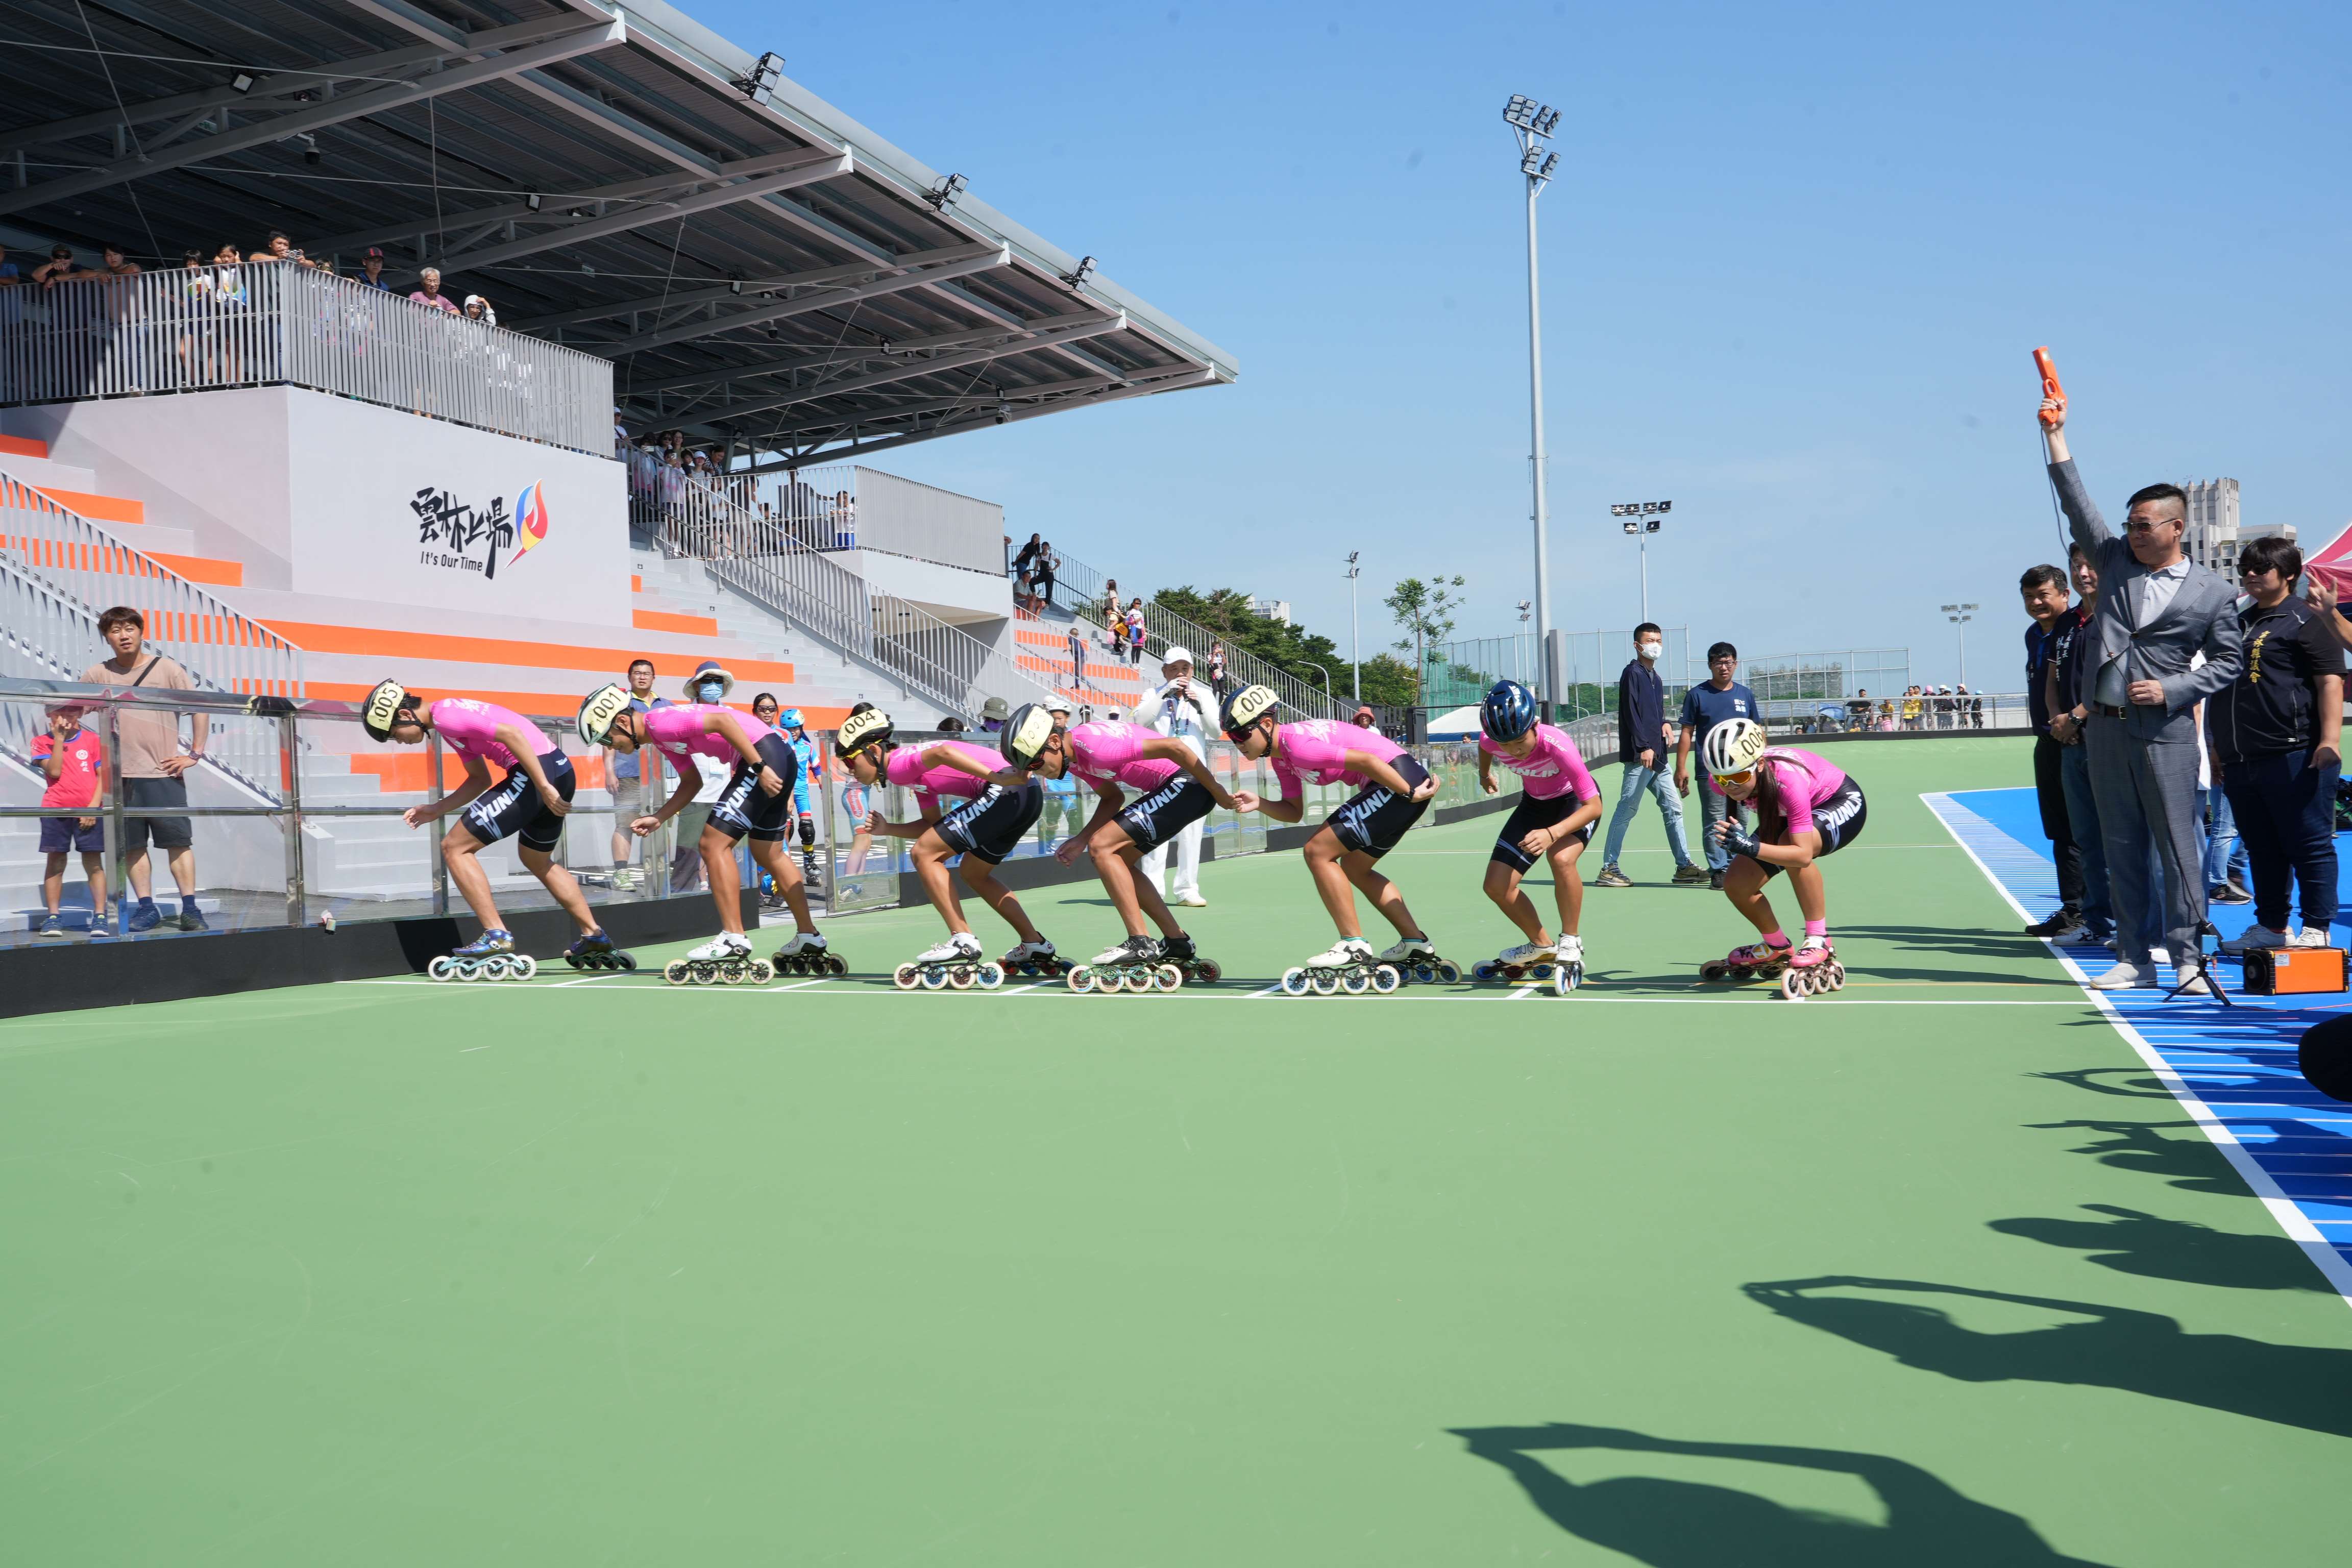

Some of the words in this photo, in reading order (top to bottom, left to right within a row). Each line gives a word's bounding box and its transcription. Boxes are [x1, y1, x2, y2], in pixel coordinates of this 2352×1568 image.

[421, 551, 438, 566] It's
[441, 554, 459, 569] Our
[460, 556, 483, 572] Time
[477, 771, 529, 823] YUNLIN
[951, 783, 1003, 828] YUNLIN
